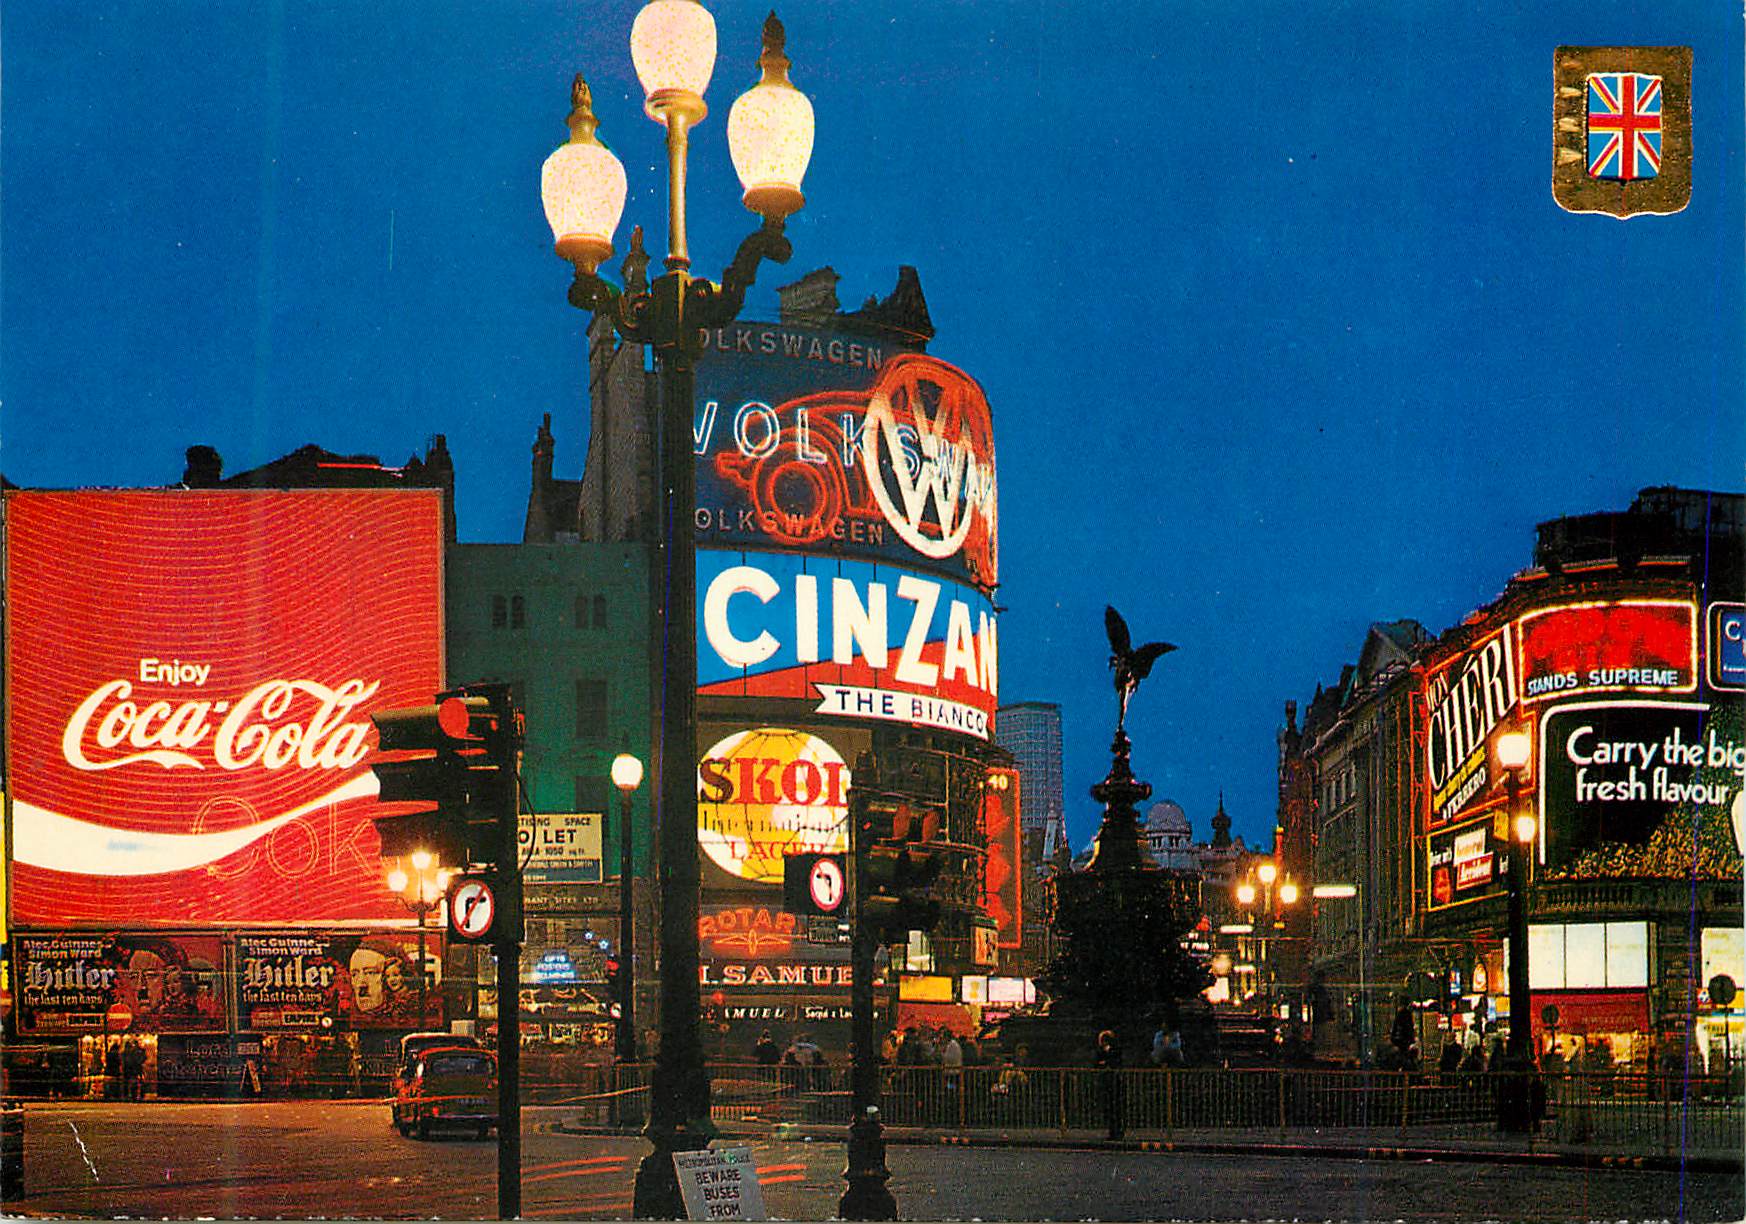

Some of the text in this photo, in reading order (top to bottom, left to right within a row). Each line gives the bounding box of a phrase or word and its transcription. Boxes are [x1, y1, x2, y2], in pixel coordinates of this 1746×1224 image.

[697, 327, 882, 369] OLKSWAGEN
[695, 508, 883, 544] OLKSWAGEN
[140, 658, 210, 683] Enjoy
[1528, 668, 1678, 695] STANDS SUPREME
[836, 690, 984, 733] THE BIANCO
[1428, 622, 1518, 790] CHÉRI
[62, 679, 381, 770] Coca-Cola
[1567, 726, 1658, 770] Carry
[1664, 727, 1703, 765] the
[1576, 767, 1729, 804] fresh flavour
[193, 795, 376, 880] COK
[518, 828, 577, 844] O LET
[249, 947, 323, 956] Simon Ward
[24, 960, 115, 994] Hitler
[242, 955, 335, 992] Hitler
[723, 965, 853, 986] SAMUE
[695, 1168, 742, 1185] BEWARE
[703, 1186, 740, 1201] BUSES
[710, 1203, 741, 1217] FROM
